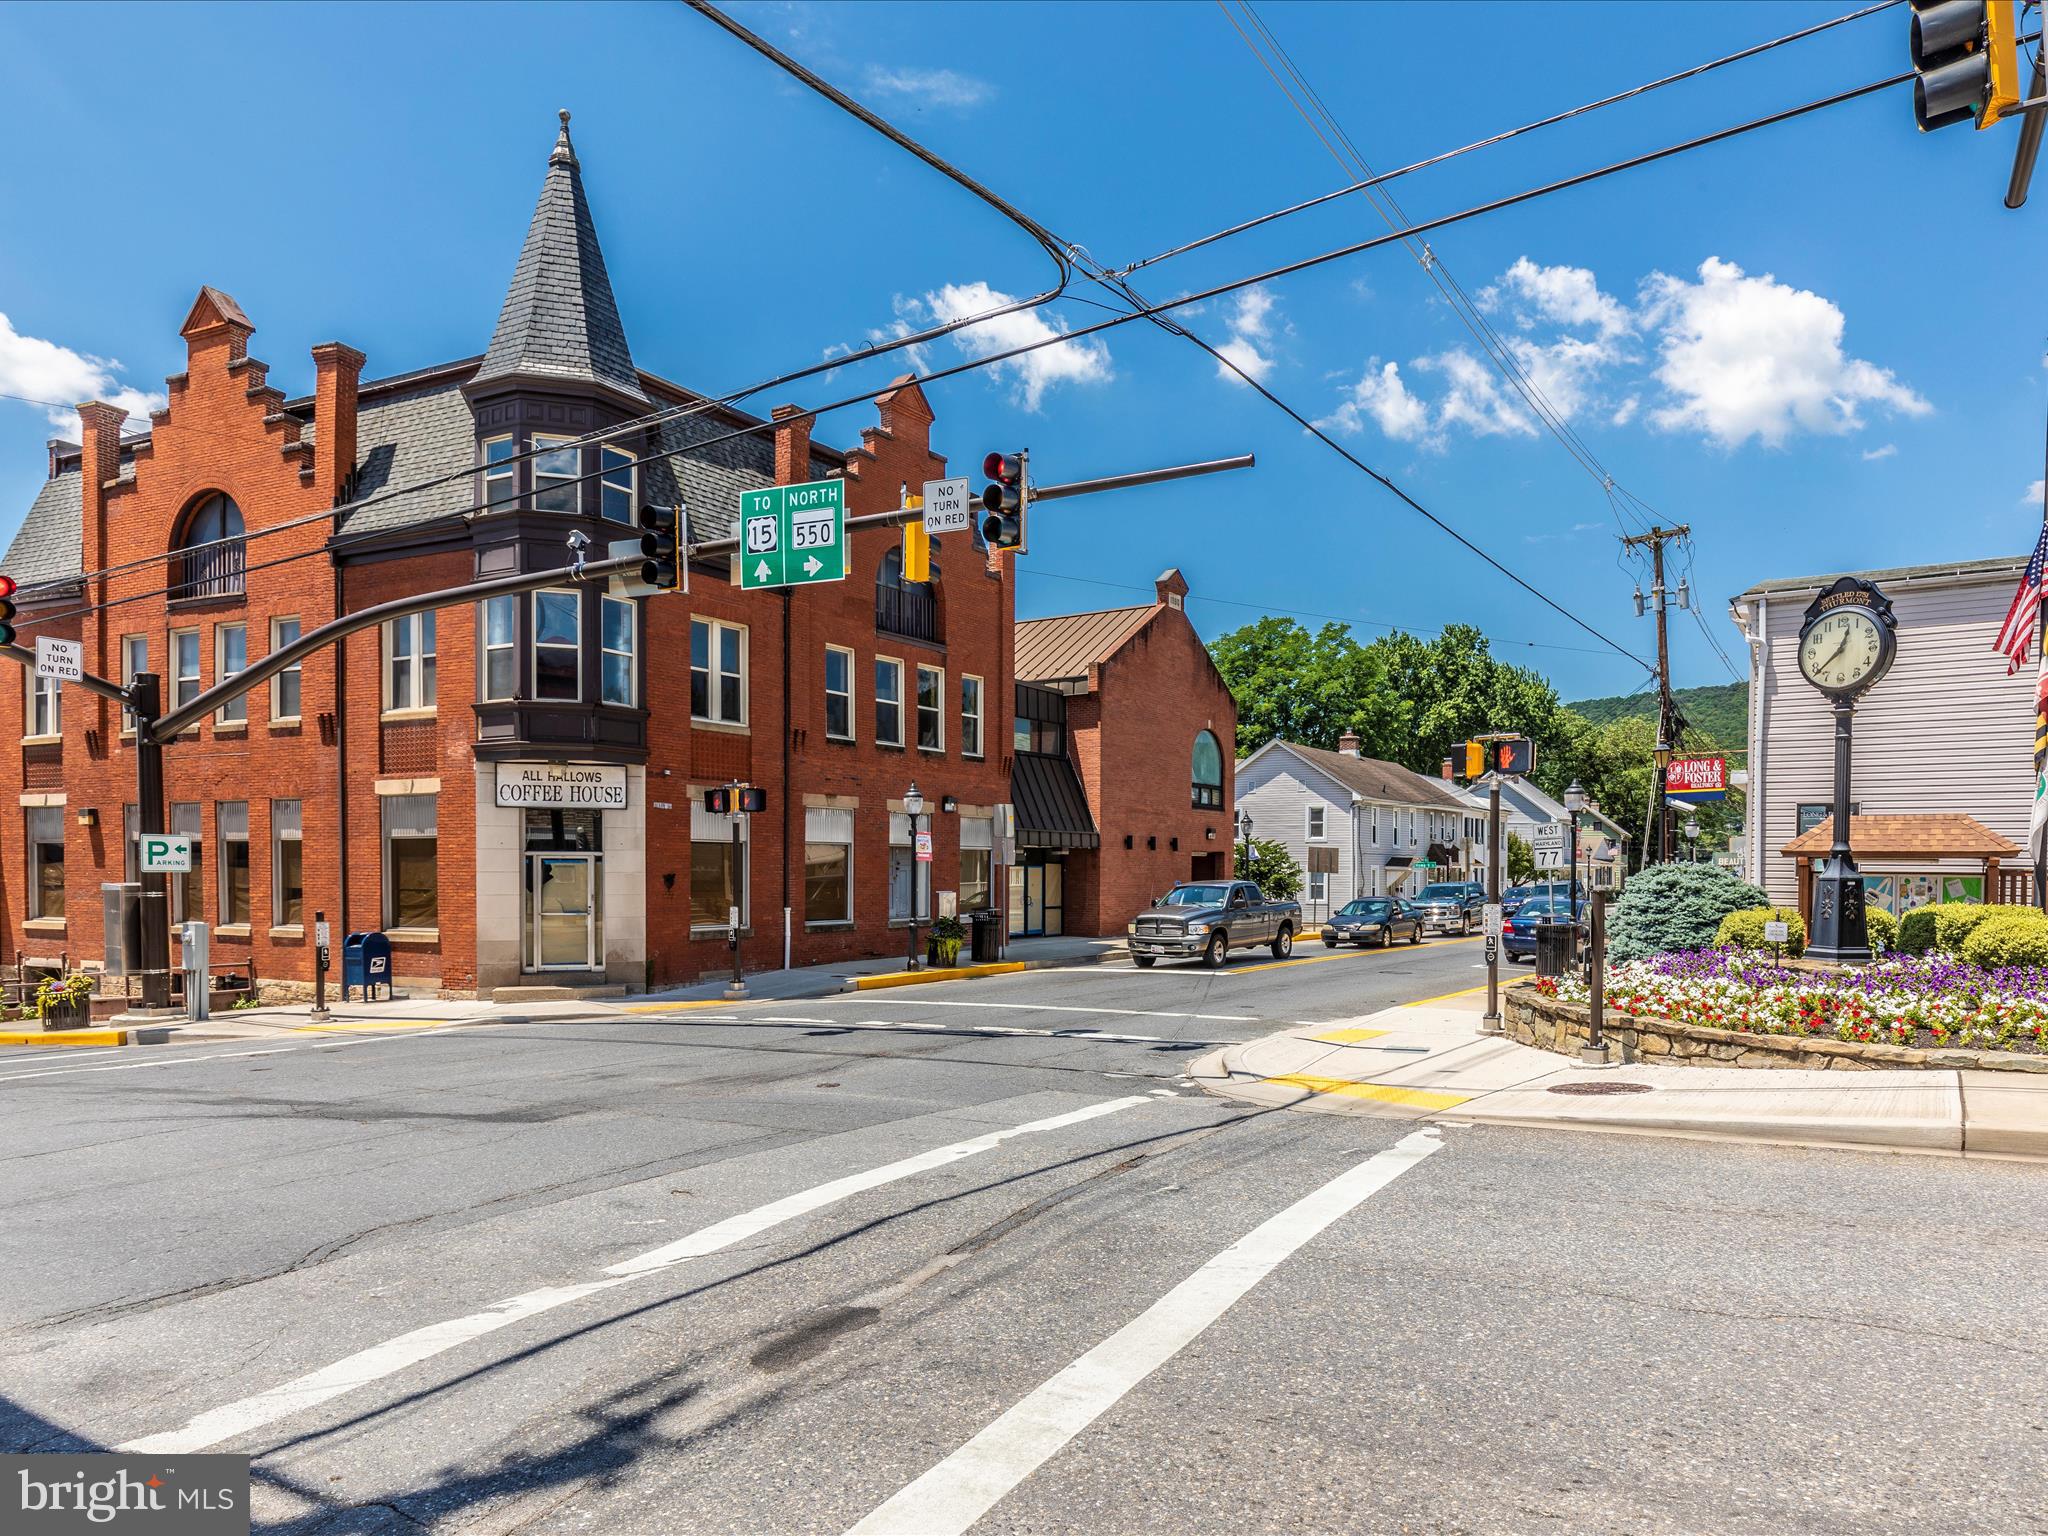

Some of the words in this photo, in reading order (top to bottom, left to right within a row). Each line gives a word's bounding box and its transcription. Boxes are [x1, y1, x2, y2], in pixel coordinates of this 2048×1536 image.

[789, 487, 838, 507] NORTH
[938, 486, 954, 497] NO
[754, 496, 771, 511] TO
[933, 499, 960, 512] TURN
[927, 516, 941, 528] ON
[945, 512, 965, 525] RED
[752, 524, 772, 546] 15
[796, 523, 831, 546] 550
[1819, 597, 1872, 612] THURMONT
[1821, 591, 1855, 605] SETTLED
[51, 644, 67, 653] NO
[46, 654, 73, 665] TURN
[40, 664, 54, 673] ON
[58, 667, 79, 676] RED
[1684, 760, 1711, 773] LONG
[1713, 760, 1722, 771] &
[522, 770, 543, 781] ALL
[547, 771, 602, 783] HALLOWS
[1684, 771, 1722, 784] FOSTER
[499, 784, 563, 801] COFFEE
[569, 785, 624, 803] HOUSE
[1537, 825, 1558, 836] WEST
[1539, 851, 1559, 866] 77
